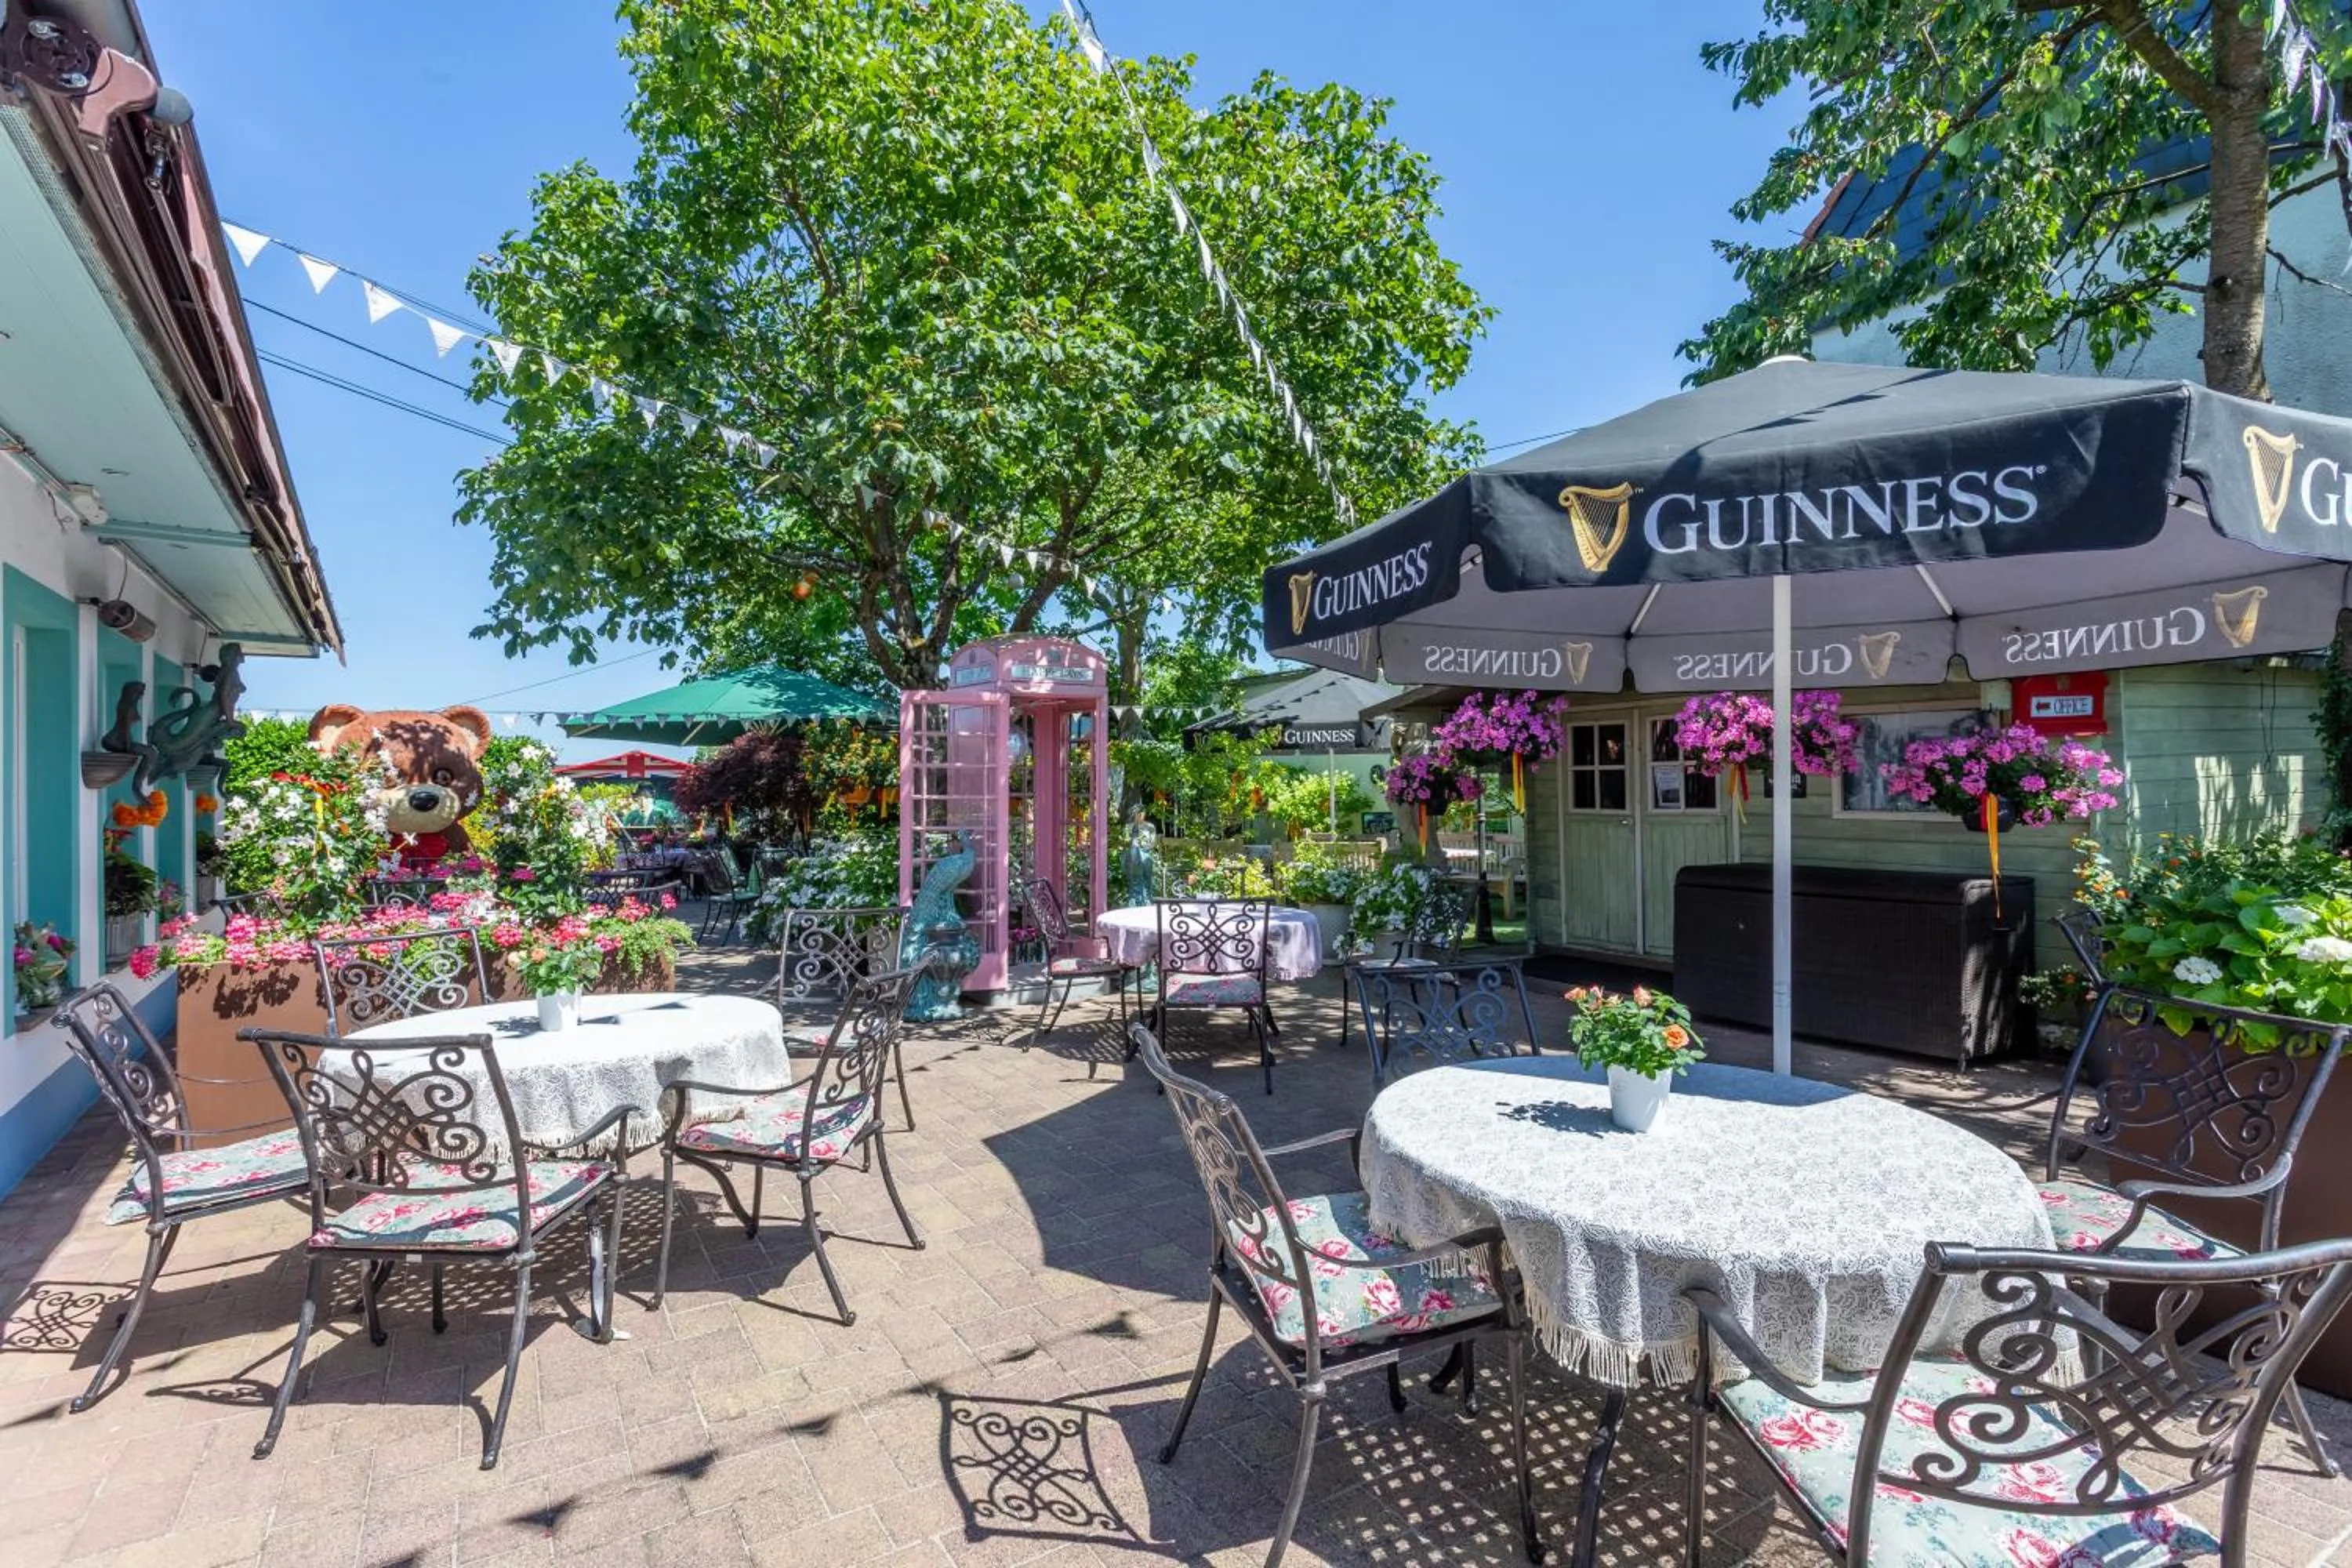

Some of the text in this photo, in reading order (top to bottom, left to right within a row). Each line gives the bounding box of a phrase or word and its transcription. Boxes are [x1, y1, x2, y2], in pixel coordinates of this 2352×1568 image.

[1643, 466, 2039, 554] GUINNESS
[1313, 543, 1430, 620] GUINNESS
[1284, 728, 1356, 744] GUINNESS
